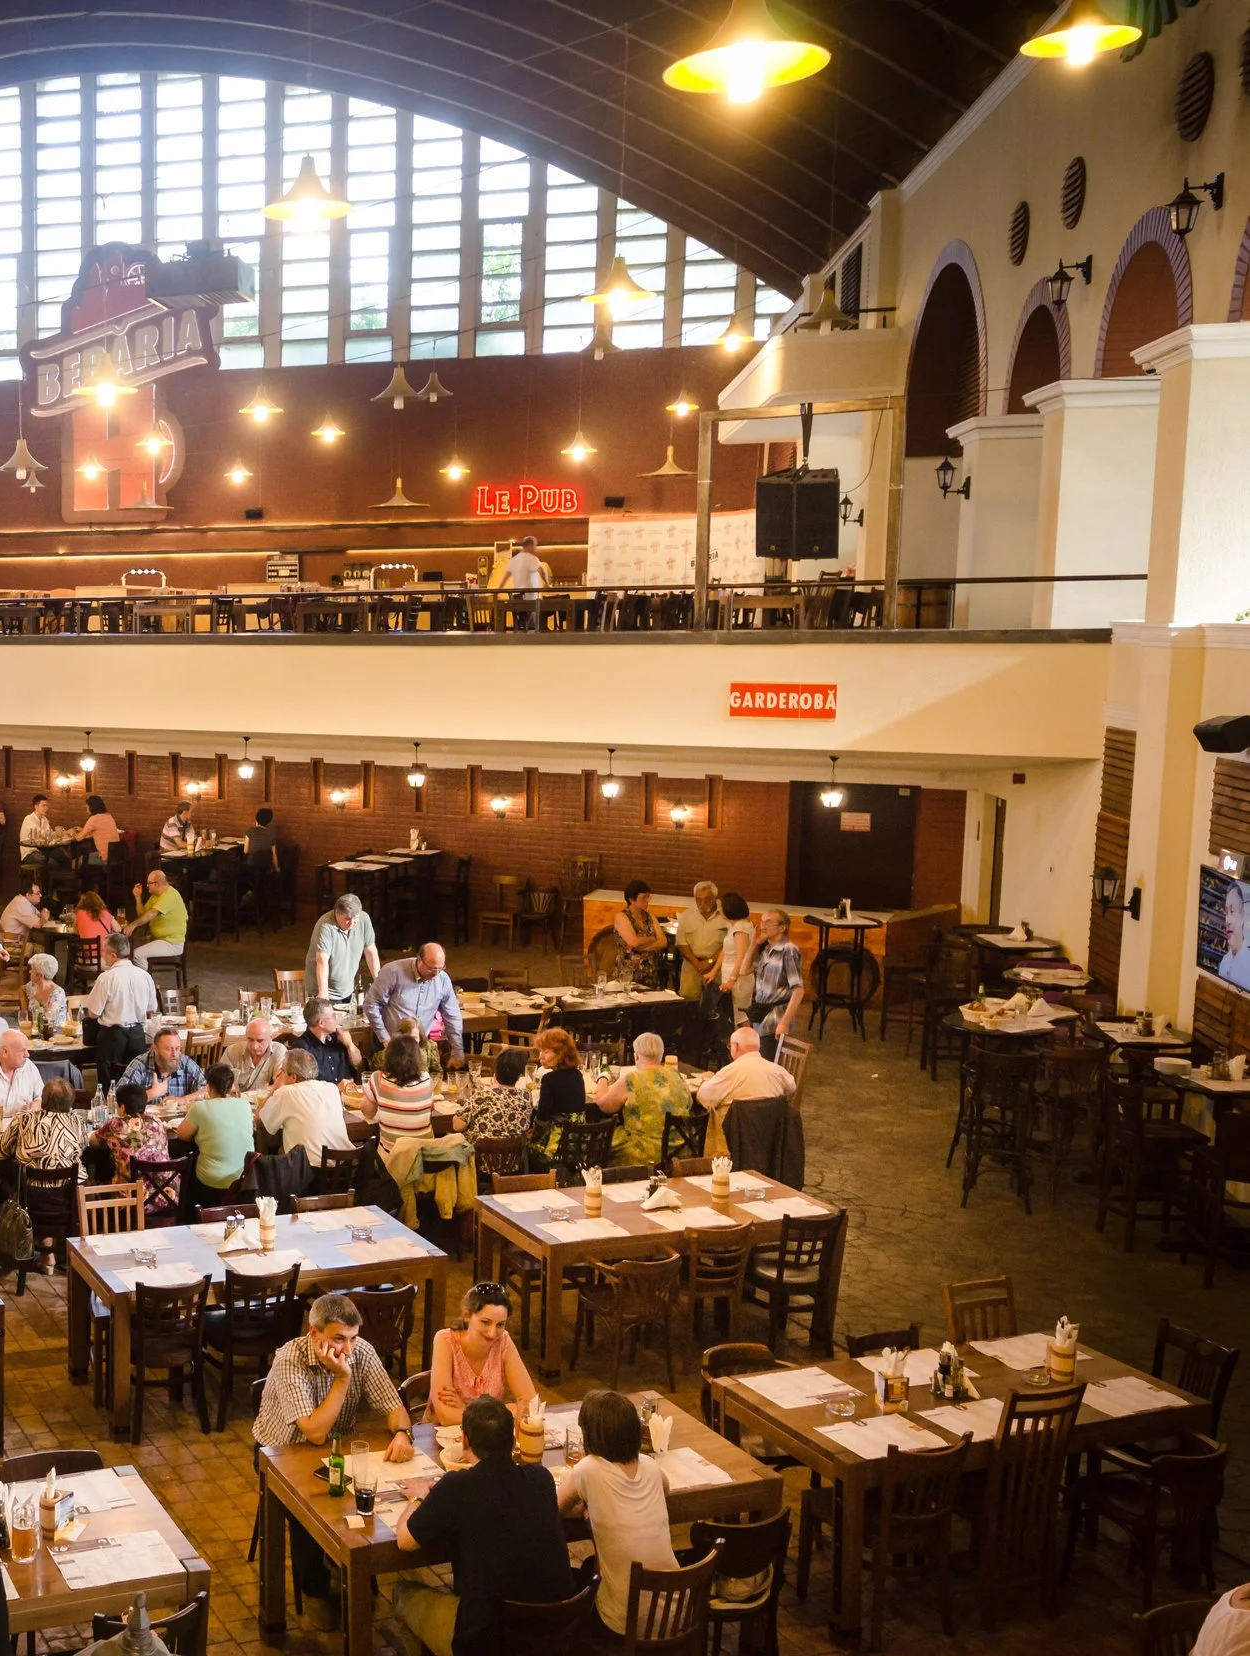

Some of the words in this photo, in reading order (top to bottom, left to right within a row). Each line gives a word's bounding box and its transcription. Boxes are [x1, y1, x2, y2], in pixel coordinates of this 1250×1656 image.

[476, 486, 510, 515] LE
[519, 484, 578, 514] PUB
[730, 689, 837, 710] GARDEROBĂ
